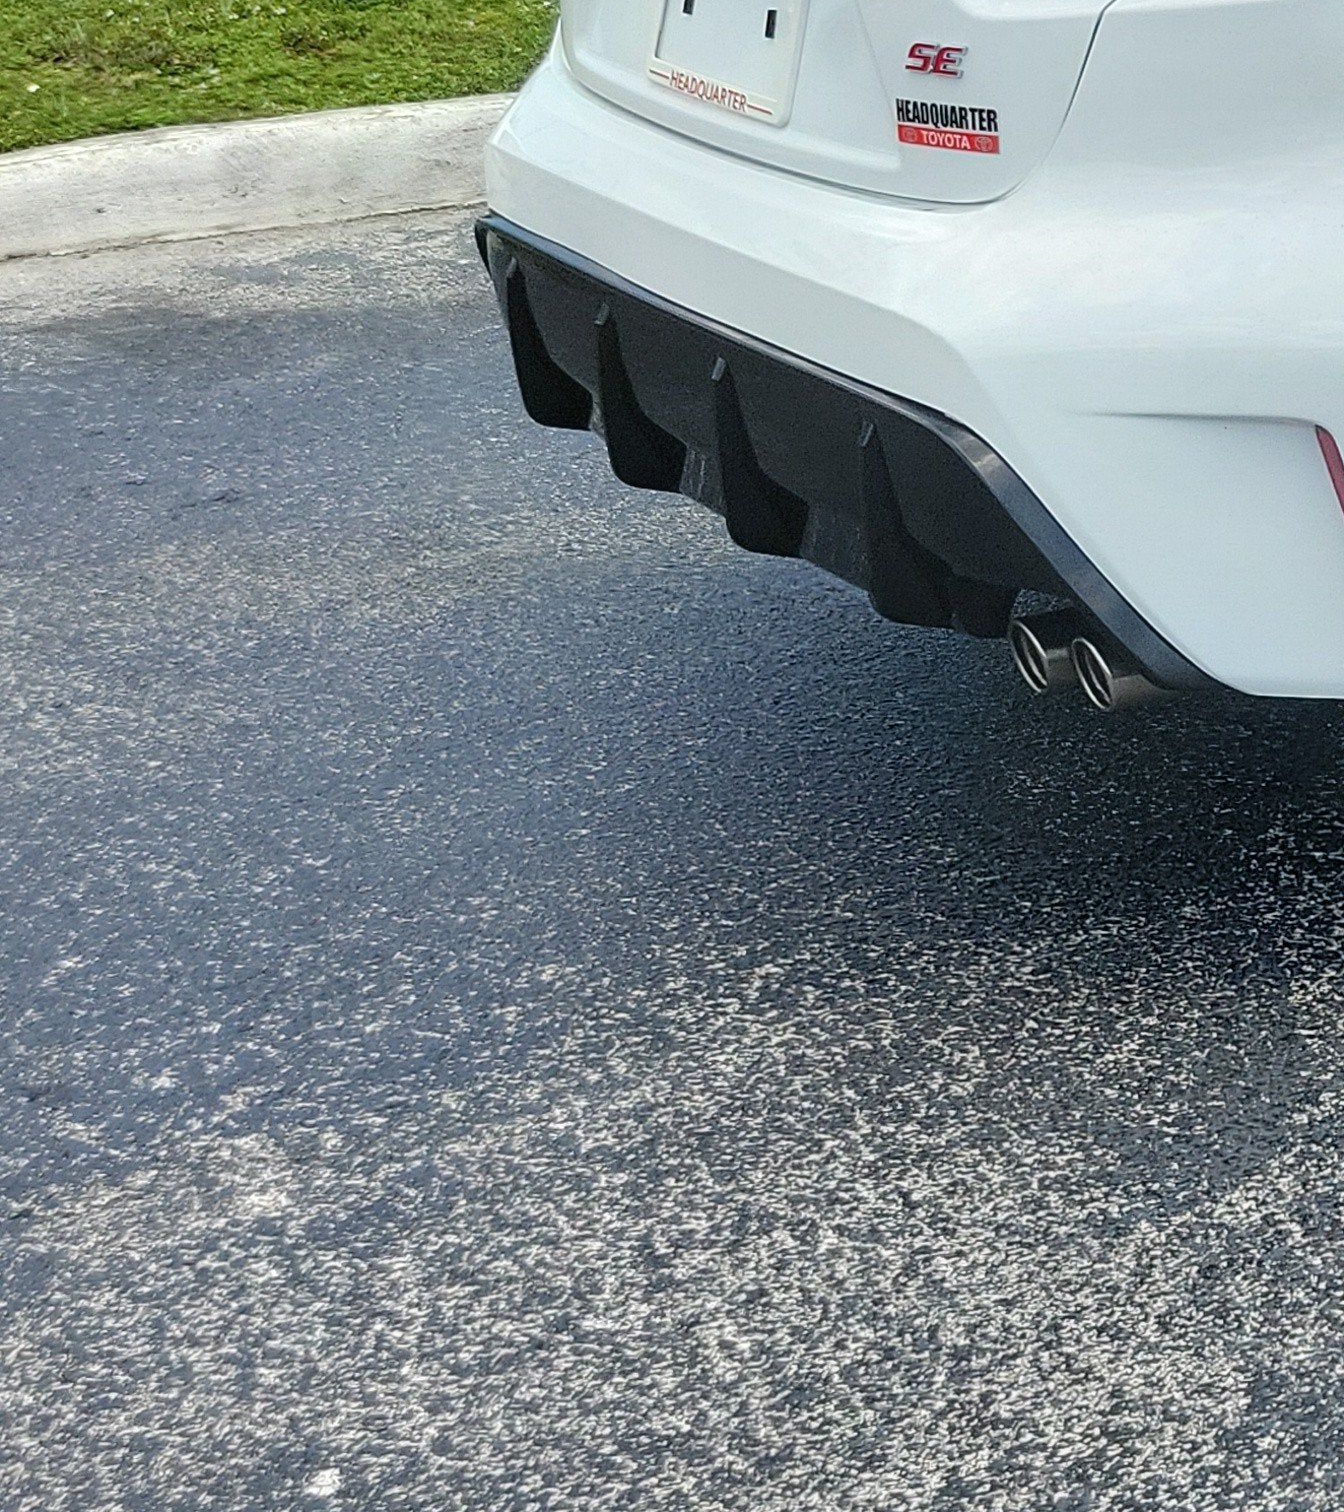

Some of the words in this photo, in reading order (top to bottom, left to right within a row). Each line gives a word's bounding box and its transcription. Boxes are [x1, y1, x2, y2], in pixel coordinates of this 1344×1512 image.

[905, 42, 968, 79] SE
[669, 69, 748, 113] HEADQUARTER
[896, 97, 999, 133] HEADQUARTER
[919, 129, 972, 150] TOYOTA
